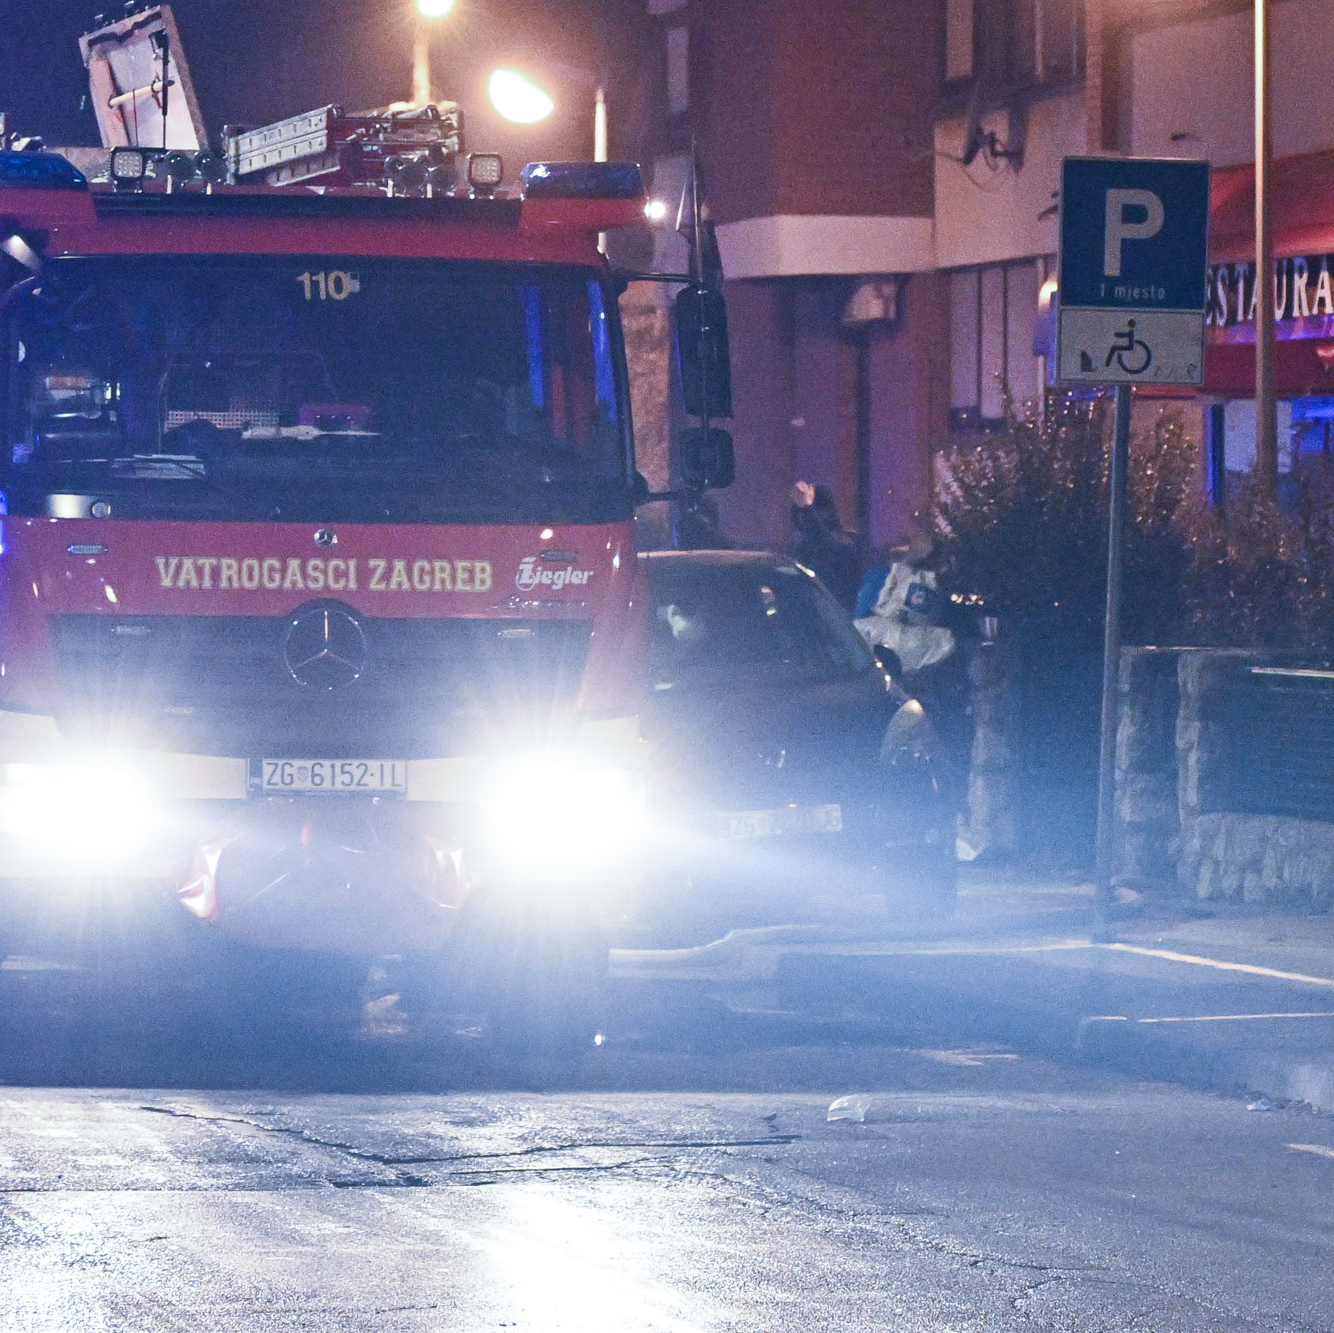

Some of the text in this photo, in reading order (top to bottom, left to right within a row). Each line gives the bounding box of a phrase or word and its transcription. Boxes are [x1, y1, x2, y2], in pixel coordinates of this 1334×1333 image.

[1103, 188, 1165, 277] P
[296, 270, 351, 300] 110
[154, 556, 494, 592] VATROGASCI ZAGREB
[515, 556, 594, 591] Ziegler
[266, 762, 295, 787] ZG
